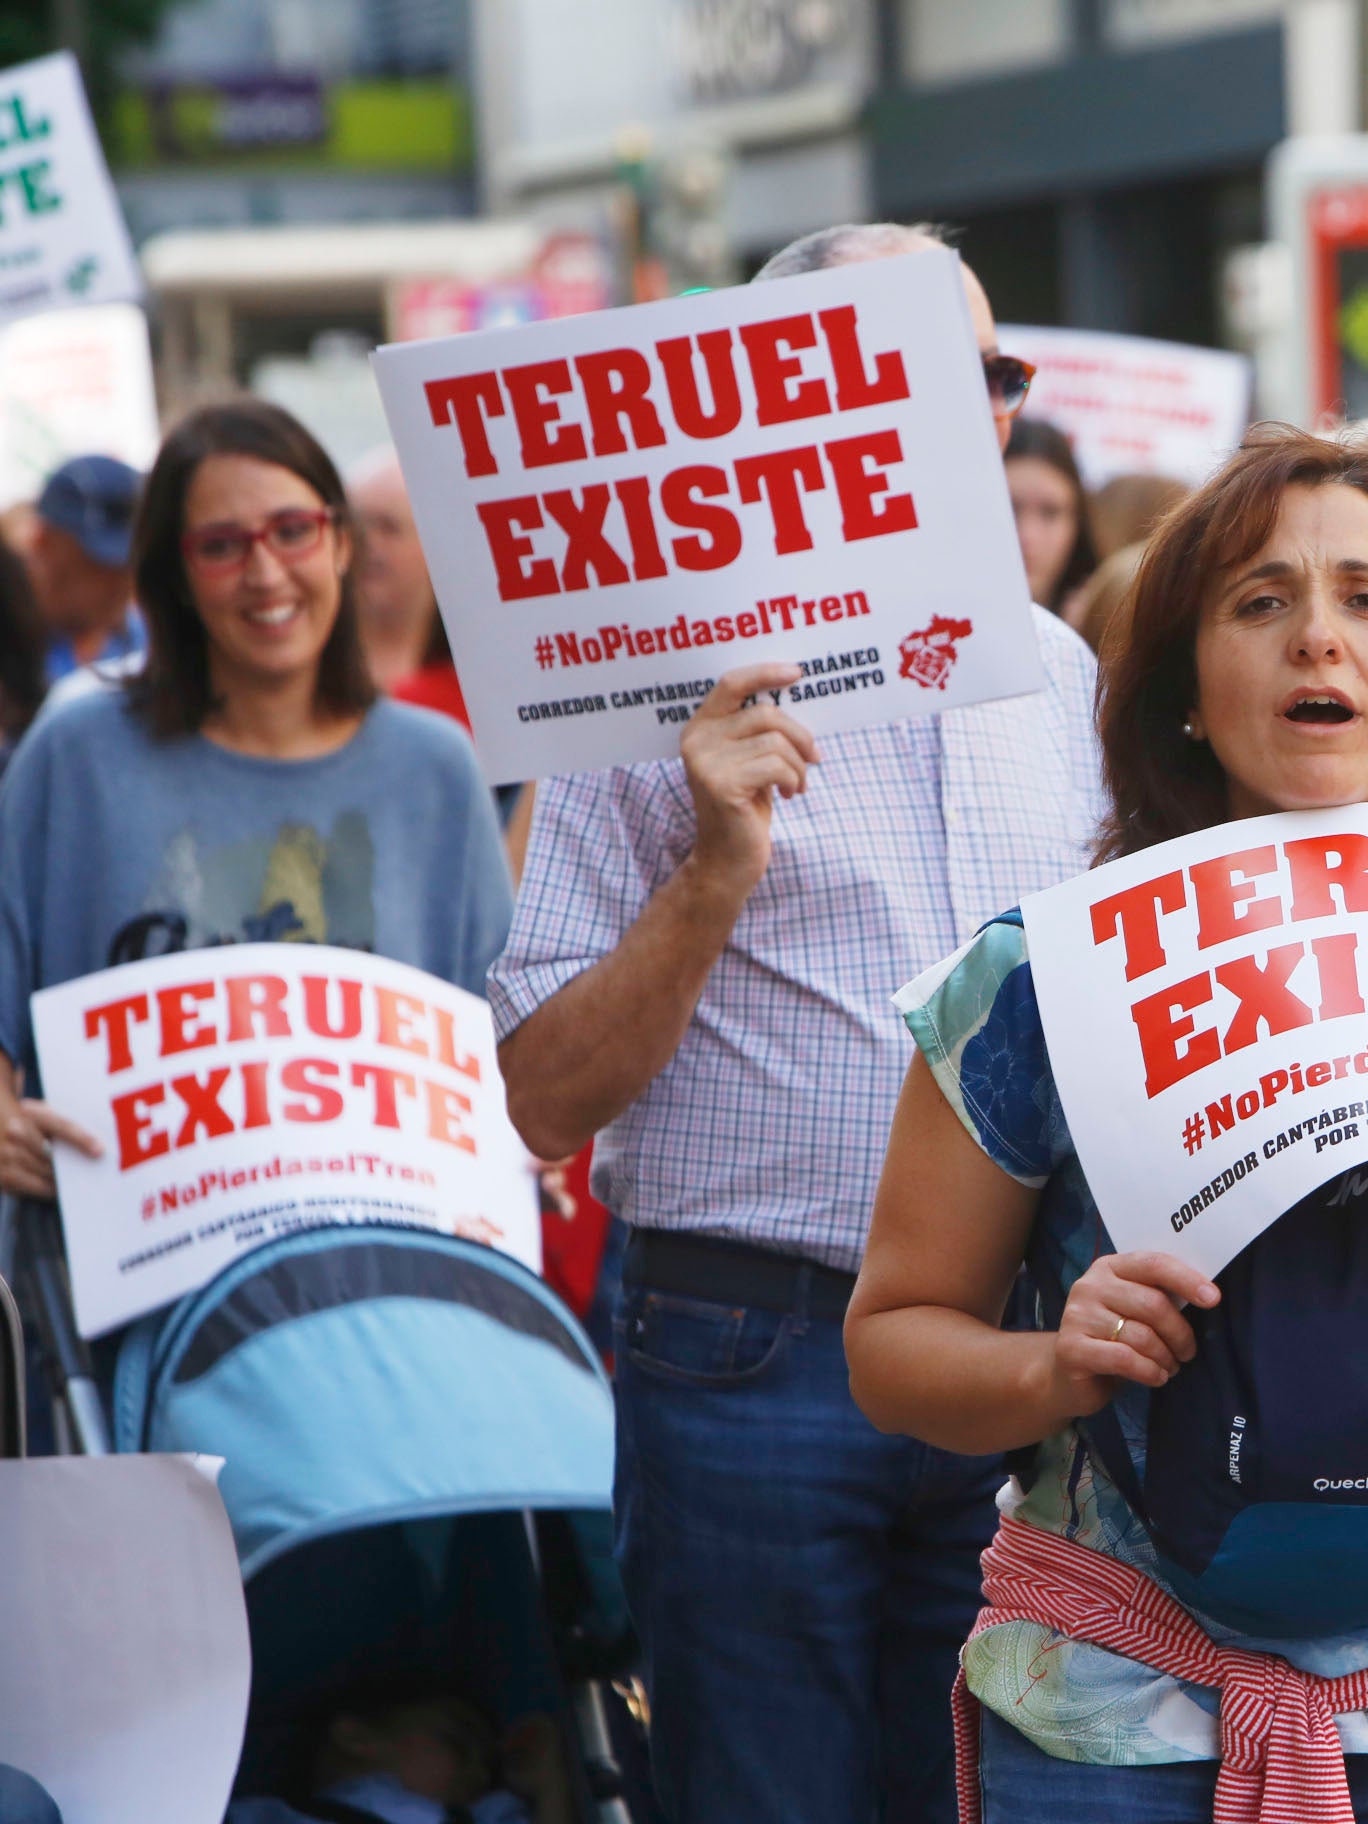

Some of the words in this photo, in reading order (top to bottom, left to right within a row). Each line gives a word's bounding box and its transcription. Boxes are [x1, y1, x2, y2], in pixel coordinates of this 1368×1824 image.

[424, 304, 910, 478] TERUEL
[476, 429, 918, 602] EXISTE
[534, 590, 871, 671] #NoPierdaselTren
[517, 693, 607, 723] CORREDOR
[657, 706, 691, 725] POR
[791, 668, 886, 704] SAGUNTO
[83, 974, 481, 1084] TERUEL
[110, 1057, 478, 1172] EXISTE
[1314, 1125, 1361, 1154] POR
[1170, 1151, 1259, 1234] CORREDOR
[1229, 1431, 1243, 1484] ARPENAZ
